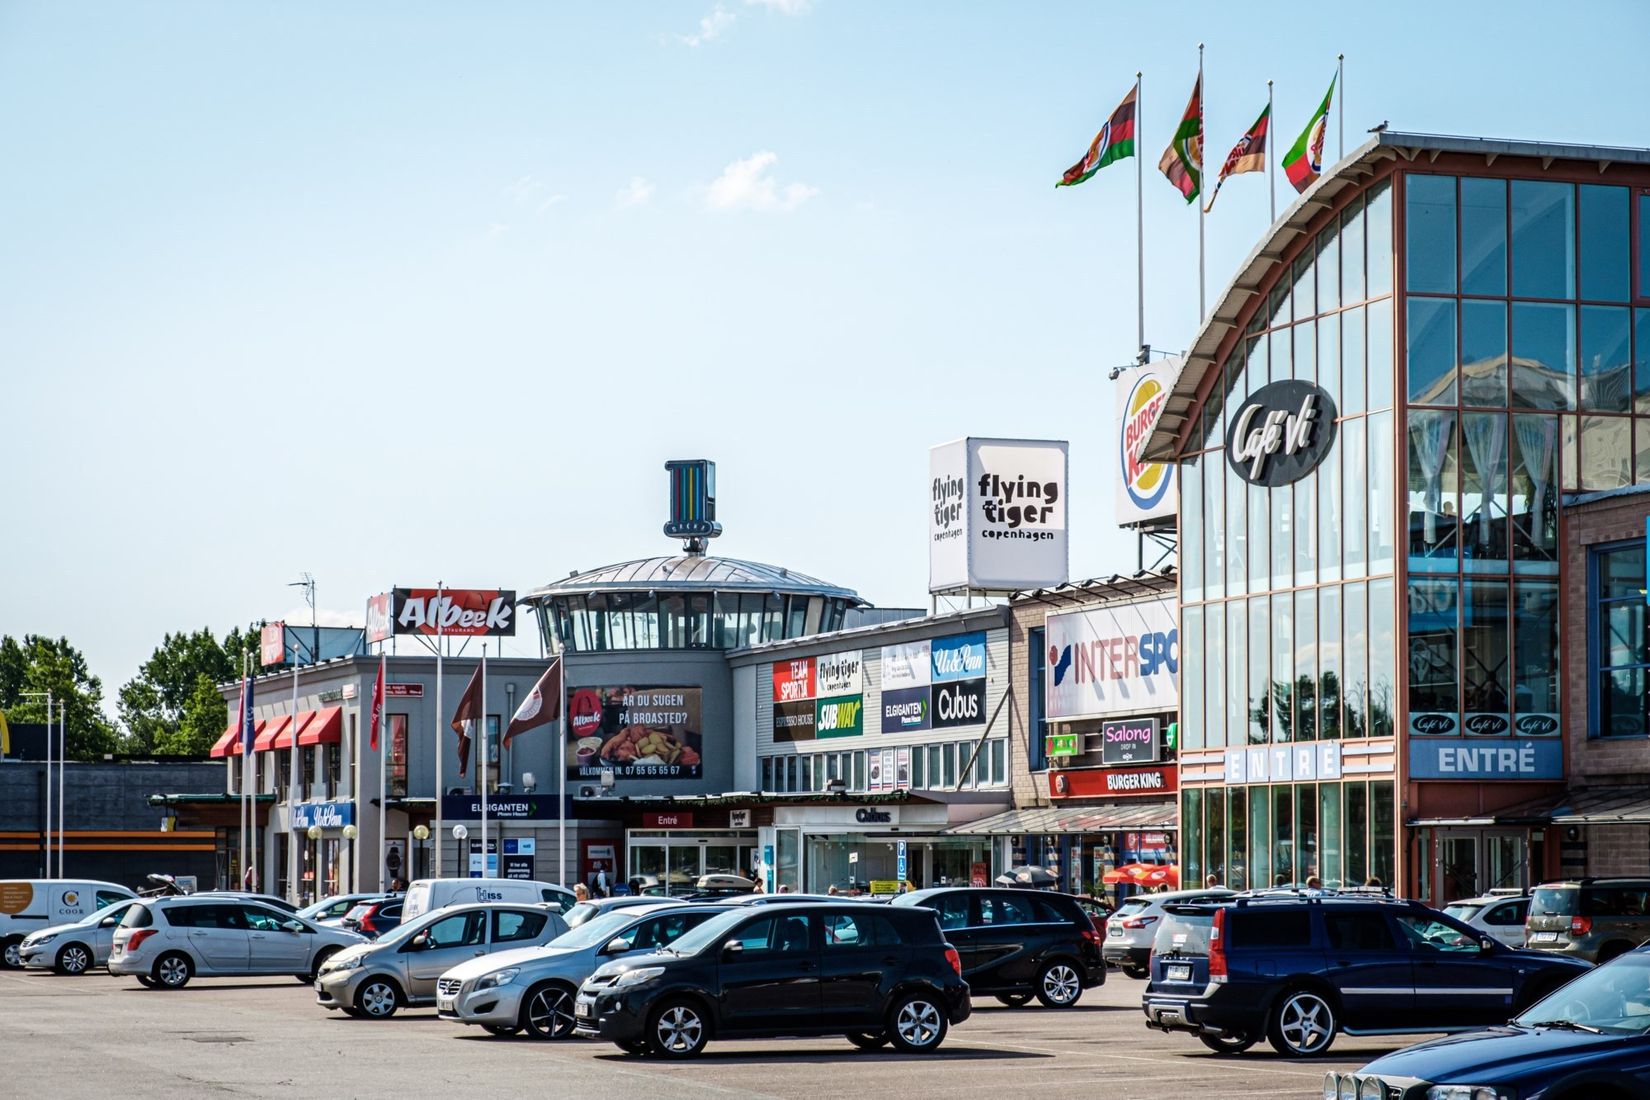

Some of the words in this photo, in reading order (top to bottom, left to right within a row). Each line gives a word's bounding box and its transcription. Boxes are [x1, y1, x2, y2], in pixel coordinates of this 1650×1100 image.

[1233, 403, 1288, 480] Café
[1285, 394, 1316, 455] Vi
[932, 474, 964, 505] flying
[978, 473, 1058, 504] flying
[934, 501, 962, 528] tiger
[982, 499, 1053, 528] tiger
[934, 528, 962, 541] copenhagen
[982, 529, 1054, 541] copenhagen
[398, 596, 512, 629] Albeek
[790, 660, 808, 679] TEAM
[819, 661, 840, 681] flying
[841, 658, 859, 679] tiger
[781, 680, 808, 700] SPORTIA
[826, 681, 851, 691] copenhagen
[622, 694, 635, 706] ÄR
[638, 694, 650, 706] DU
[653, 694, 684, 706] SUGEN
[886, 702, 922, 717] ELGIGANTEN
[938, 685, 978, 720] Cubus
[619, 710, 630, 724] PÅ
[633, 712, 688, 724] BROASTED?
[798, 713, 814, 726] HOUSE
[817, 699, 861, 731] SUBWAY
[1417, 714, 1438, 733] Café
[1439, 718, 1450, 729] Vi
[1471, 714, 1491, 733] Café
[1492, 718, 1502, 729] Vi
[1520, 714, 1541, 733] Café
[1542, 718, 1552, 729] Vi
[1106, 726, 1151, 744] Salong
[1231, 740, 1334, 779] ENTRÉ
[1438, 742, 1535, 772] ENTRÉ
[625, 766, 634, 775] 07
[636, 766, 646, 775] 65
[648, 766, 657, 775] 65
[659, 766, 668, 775] 65
[1107, 774, 1138, 790] BURGER
[1138, 772, 1161, 788] KING
[471, 803, 529, 812] ELIGANTEN
[856, 807, 891, 823] Cubus
[658, 815, 678, 825] Entré
